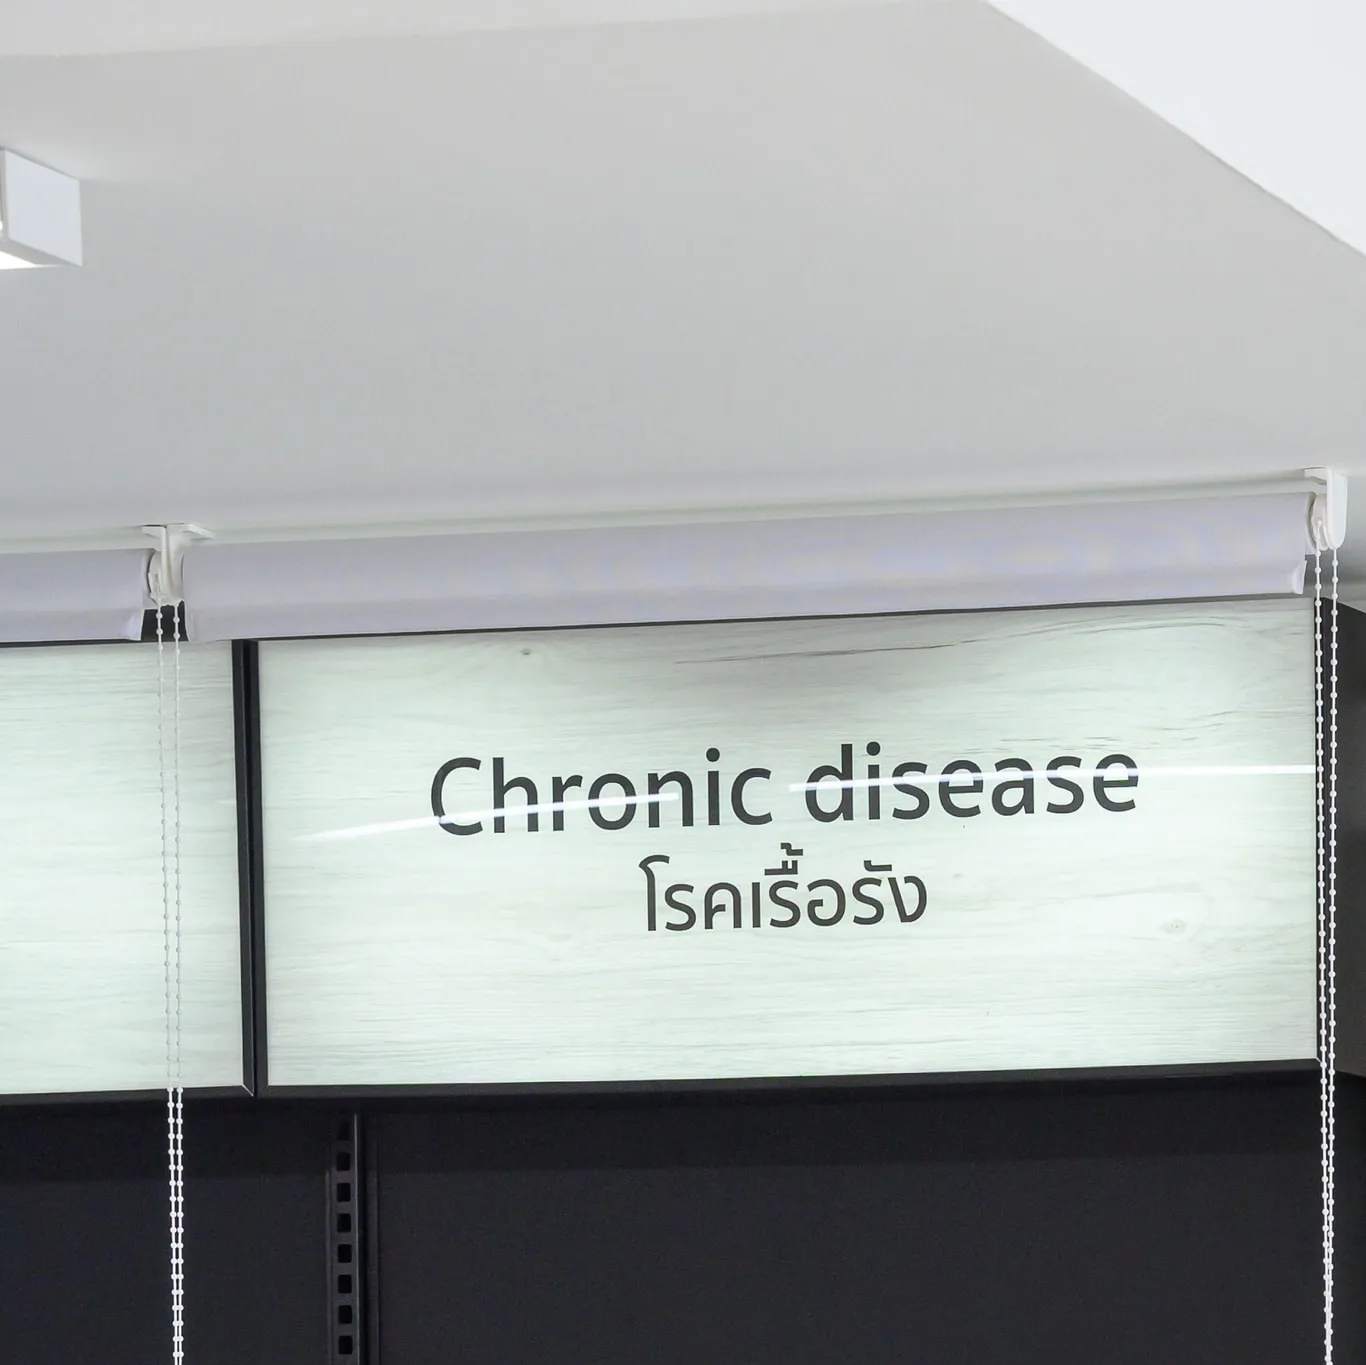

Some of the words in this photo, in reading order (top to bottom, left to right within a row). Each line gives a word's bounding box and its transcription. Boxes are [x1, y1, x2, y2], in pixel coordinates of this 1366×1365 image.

[429, 747, 773, 836] Chronic
[805, 740, 1141, 823] disease
[638, 842, 929, 932] โรคเรื้อรัง
